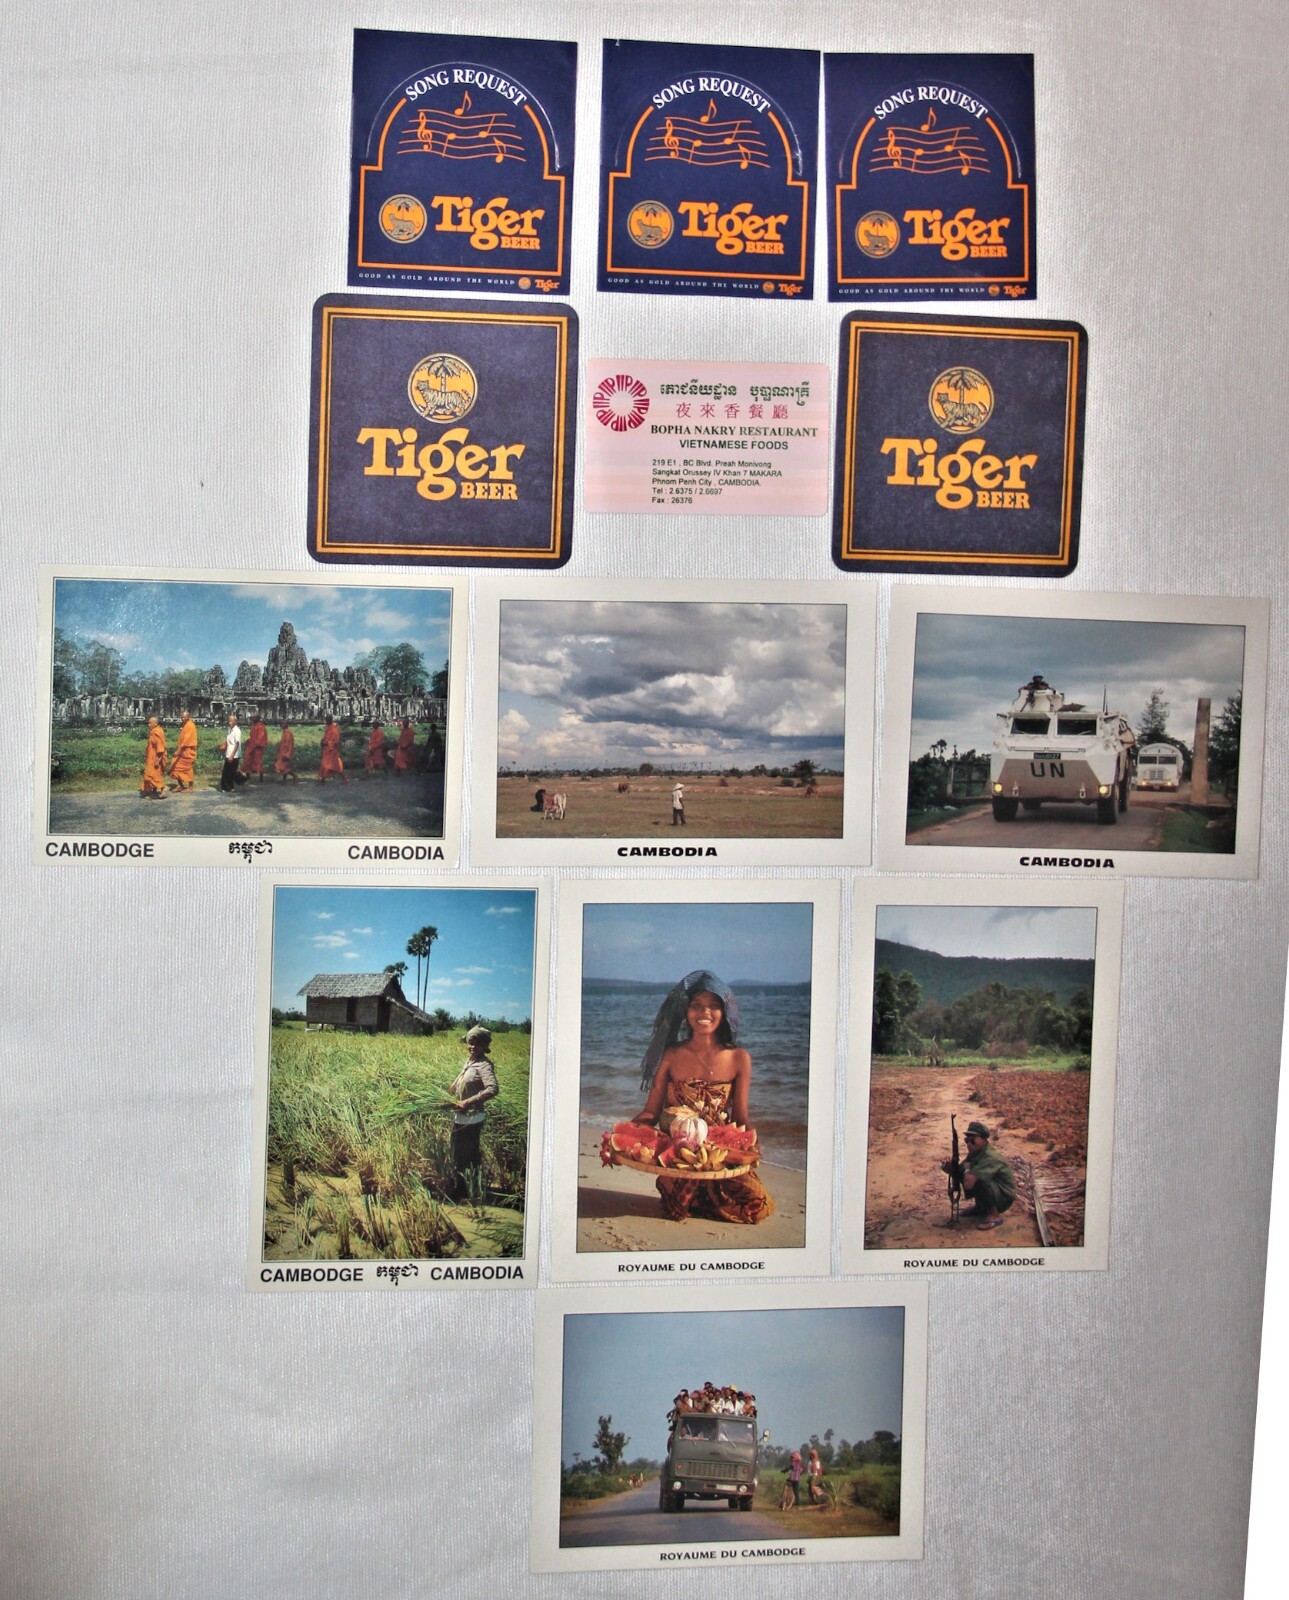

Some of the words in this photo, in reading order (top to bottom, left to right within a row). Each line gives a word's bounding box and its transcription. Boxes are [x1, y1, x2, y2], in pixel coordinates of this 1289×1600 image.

[405, 71, 449, 101] SONG
[453, 69, 527, 106] REQUEST
[652, 79, 695, 109] SONG
[698, 77, 771, 113] REQUEST
[873, 89, 915, 120] SONG
[917, 86, 988, 119] REQUEST
[431, 195, 545, 251] Tiger
[677, 201, 789, 255] Tiger
[903, 207, 1011, 261] Tiger
[501, 236, 541, 250] BEER
[745, 241, 785, 255] BEER
[970, 246, 1008, 258] BEER
[535, 279, 560, 292] Tiger
[778, 283, 803, 296] Tiger
[1003, 285, 1027, 298] Tiger
[651, 424, 691, 435] BOPHA
[694, 425, 736, 436] NAKRY
[739, 426, 818, 437] RESTAURANT
[679, 439, 748, 450] VIETNAMESE
[751, 440, 789, 450] FOODS
[356, 427, 526, 501] Tiger
[652, 468, 681, 476] Sangkat
[683, 469, 711, 477] Orussey
[880, 438, 1038, 510] Tiger
[698, 478, 712, 486] City
[460, 481, 518, 501] BEER
[976, 491, 1031, 509] BEER
[1030, 762, 1065, 778] UN
[45, 842, 155, 858] CAMBODGE
[347, 845, 445, 861] CAMBODIA
[617, 847, 718, 857] CAMBODIA
[1019, 856, 1115, 869] CAMBODIA
[618, 1263, 675, 1272] ROYAUME
[679, 1263, 696, 1271] DU
[700, 1261, 765, 1270] CAMBODGE
[903, 1259, 958, 1268] ROYAUME
[963, 1258, 978, 1267] DU
[982, 1257, 1045, 1266] CAMBODGE
[260, 1268, 364, 1283] CAMBODGE
[430, 1266, 524, 1281] CAMBODIA
[660, 1550, 717, 1561] ROYAUME
[721, 1549, 737, 1558] DU
[741, 1547, 806, 1557] CAMBODGE
